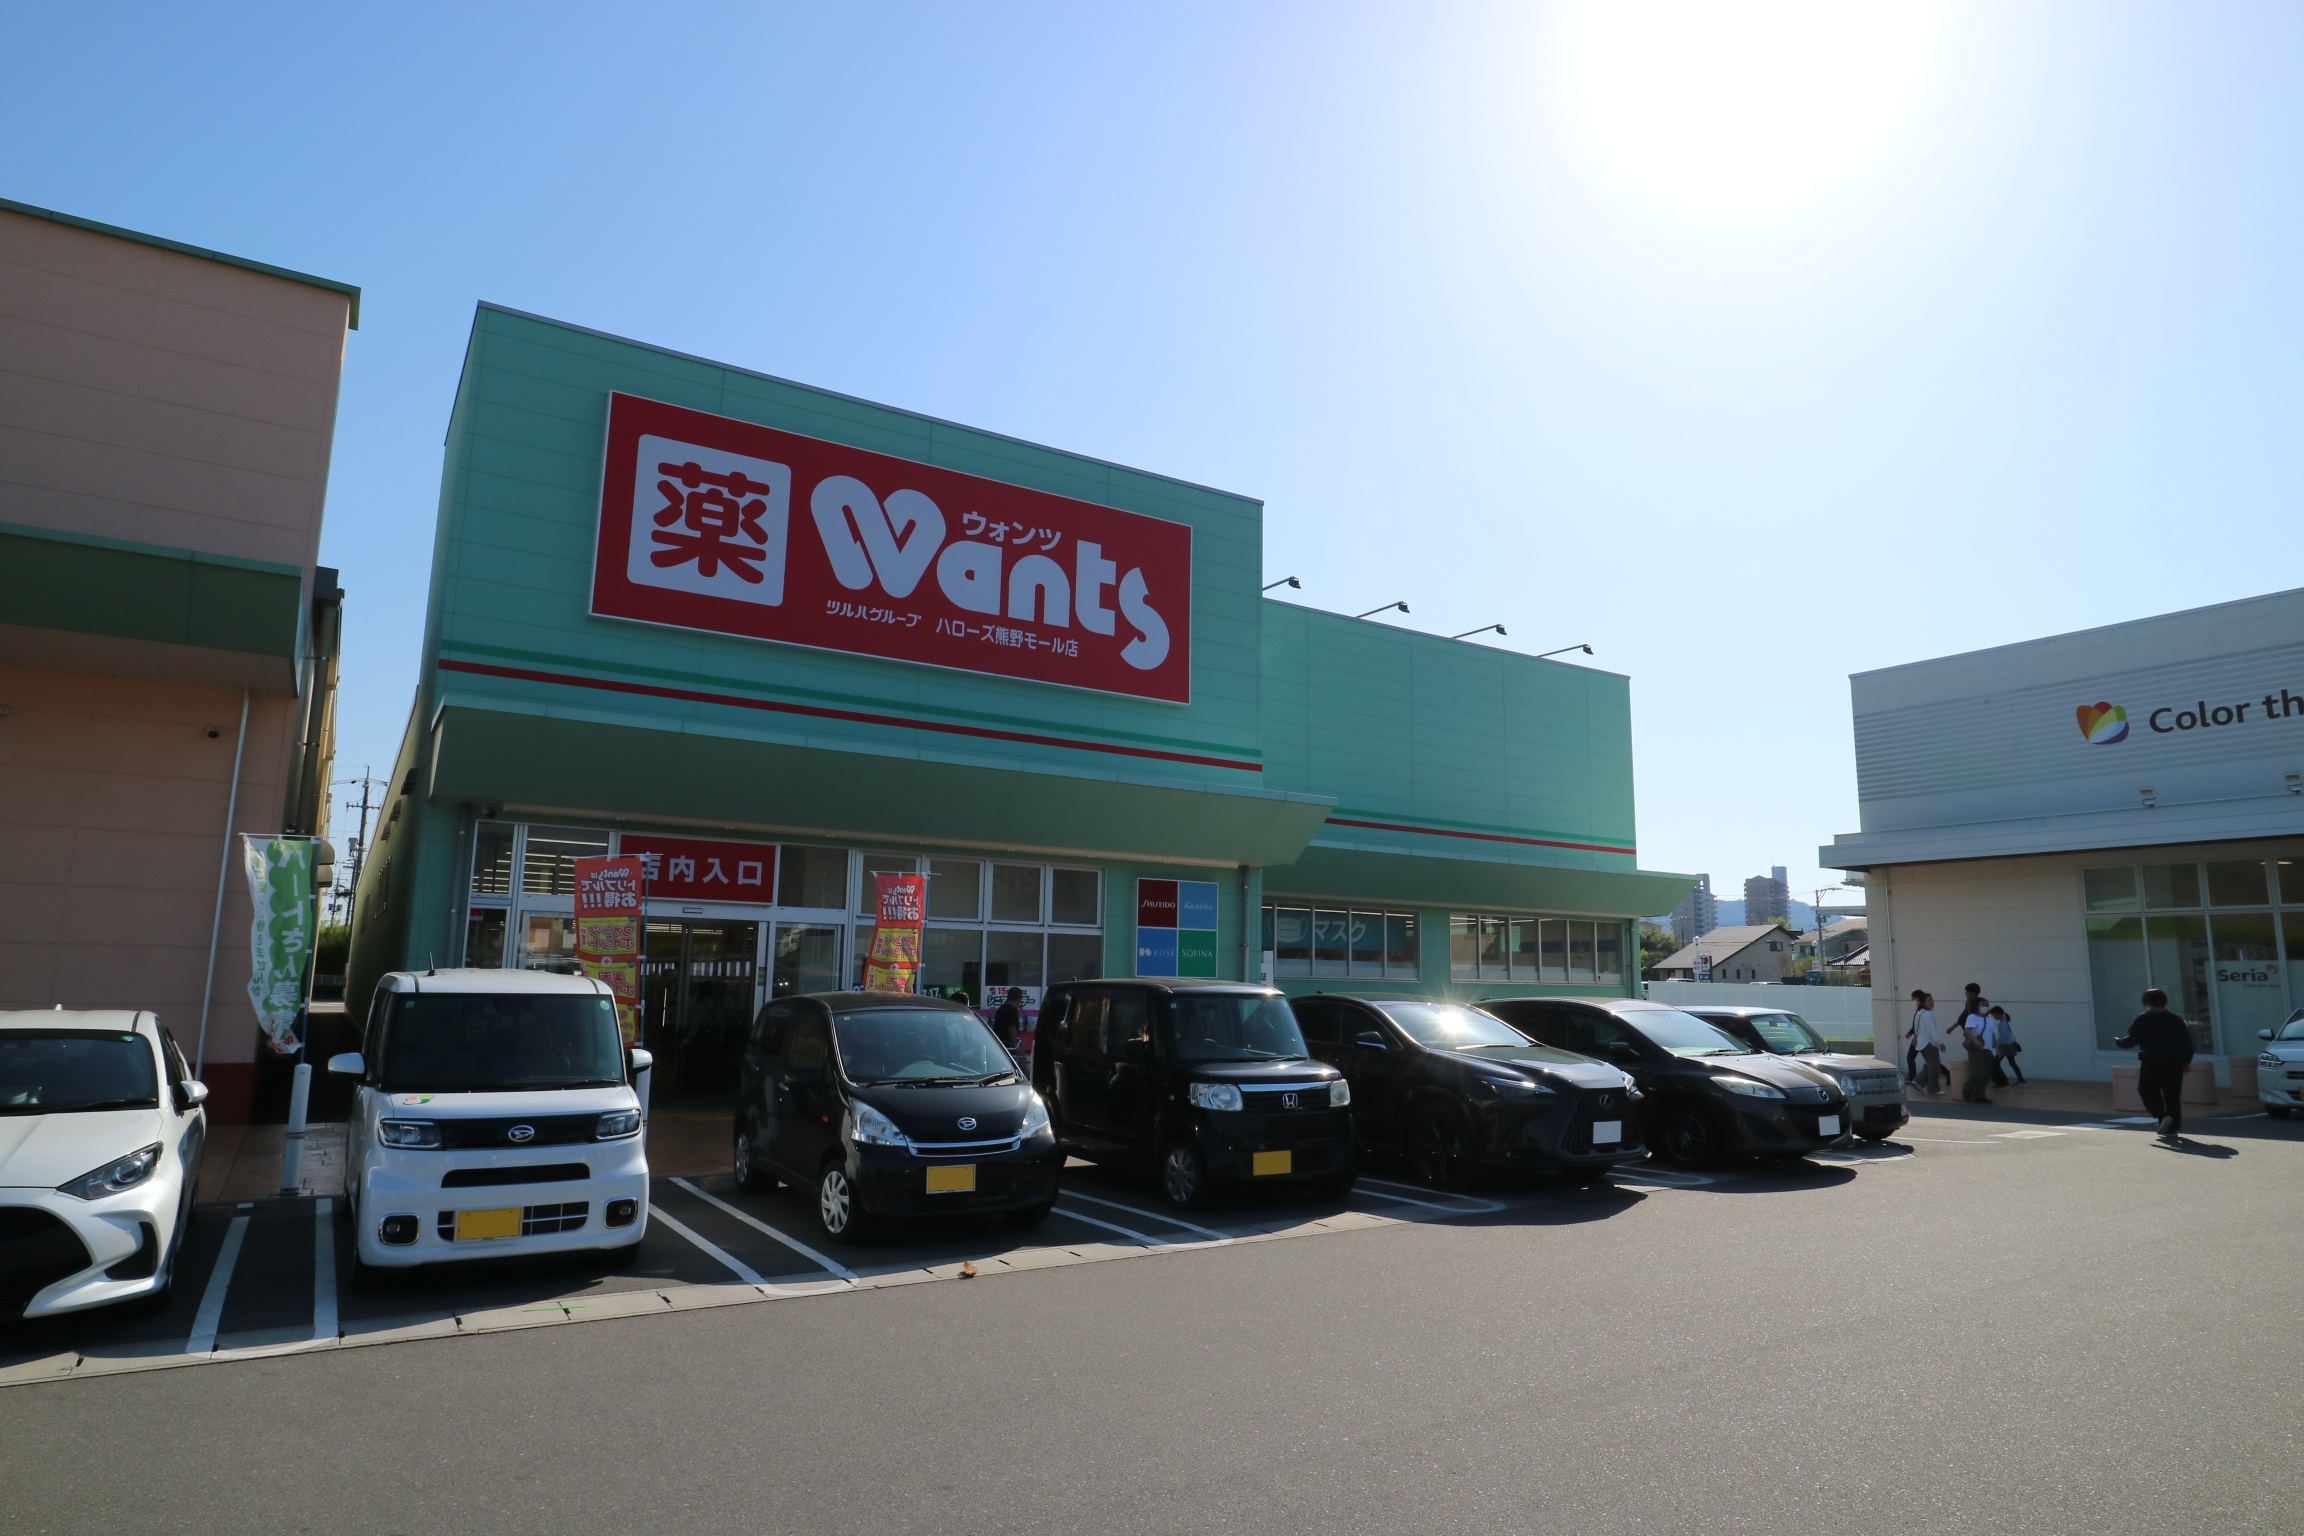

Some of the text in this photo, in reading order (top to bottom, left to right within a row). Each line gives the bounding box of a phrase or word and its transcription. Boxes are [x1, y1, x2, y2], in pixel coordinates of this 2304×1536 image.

[649, 461, 772, 585] 薬
[962, 511, 1062, 550] ウォンツ
[811, 475, 1171, 670] Wants
[826, 600, 1078, 657] ツルハグループ ハローズ熊野モール店
[2149, 700, 2251, 733] Color
[1141, 899, 1213, 910] SHISEIDO Kanebo
[1314, 920, 1366, 943] マスク
[1182, 949, 1213, 958] SOFINA
[2217, 968, 2269, 982] Seria
